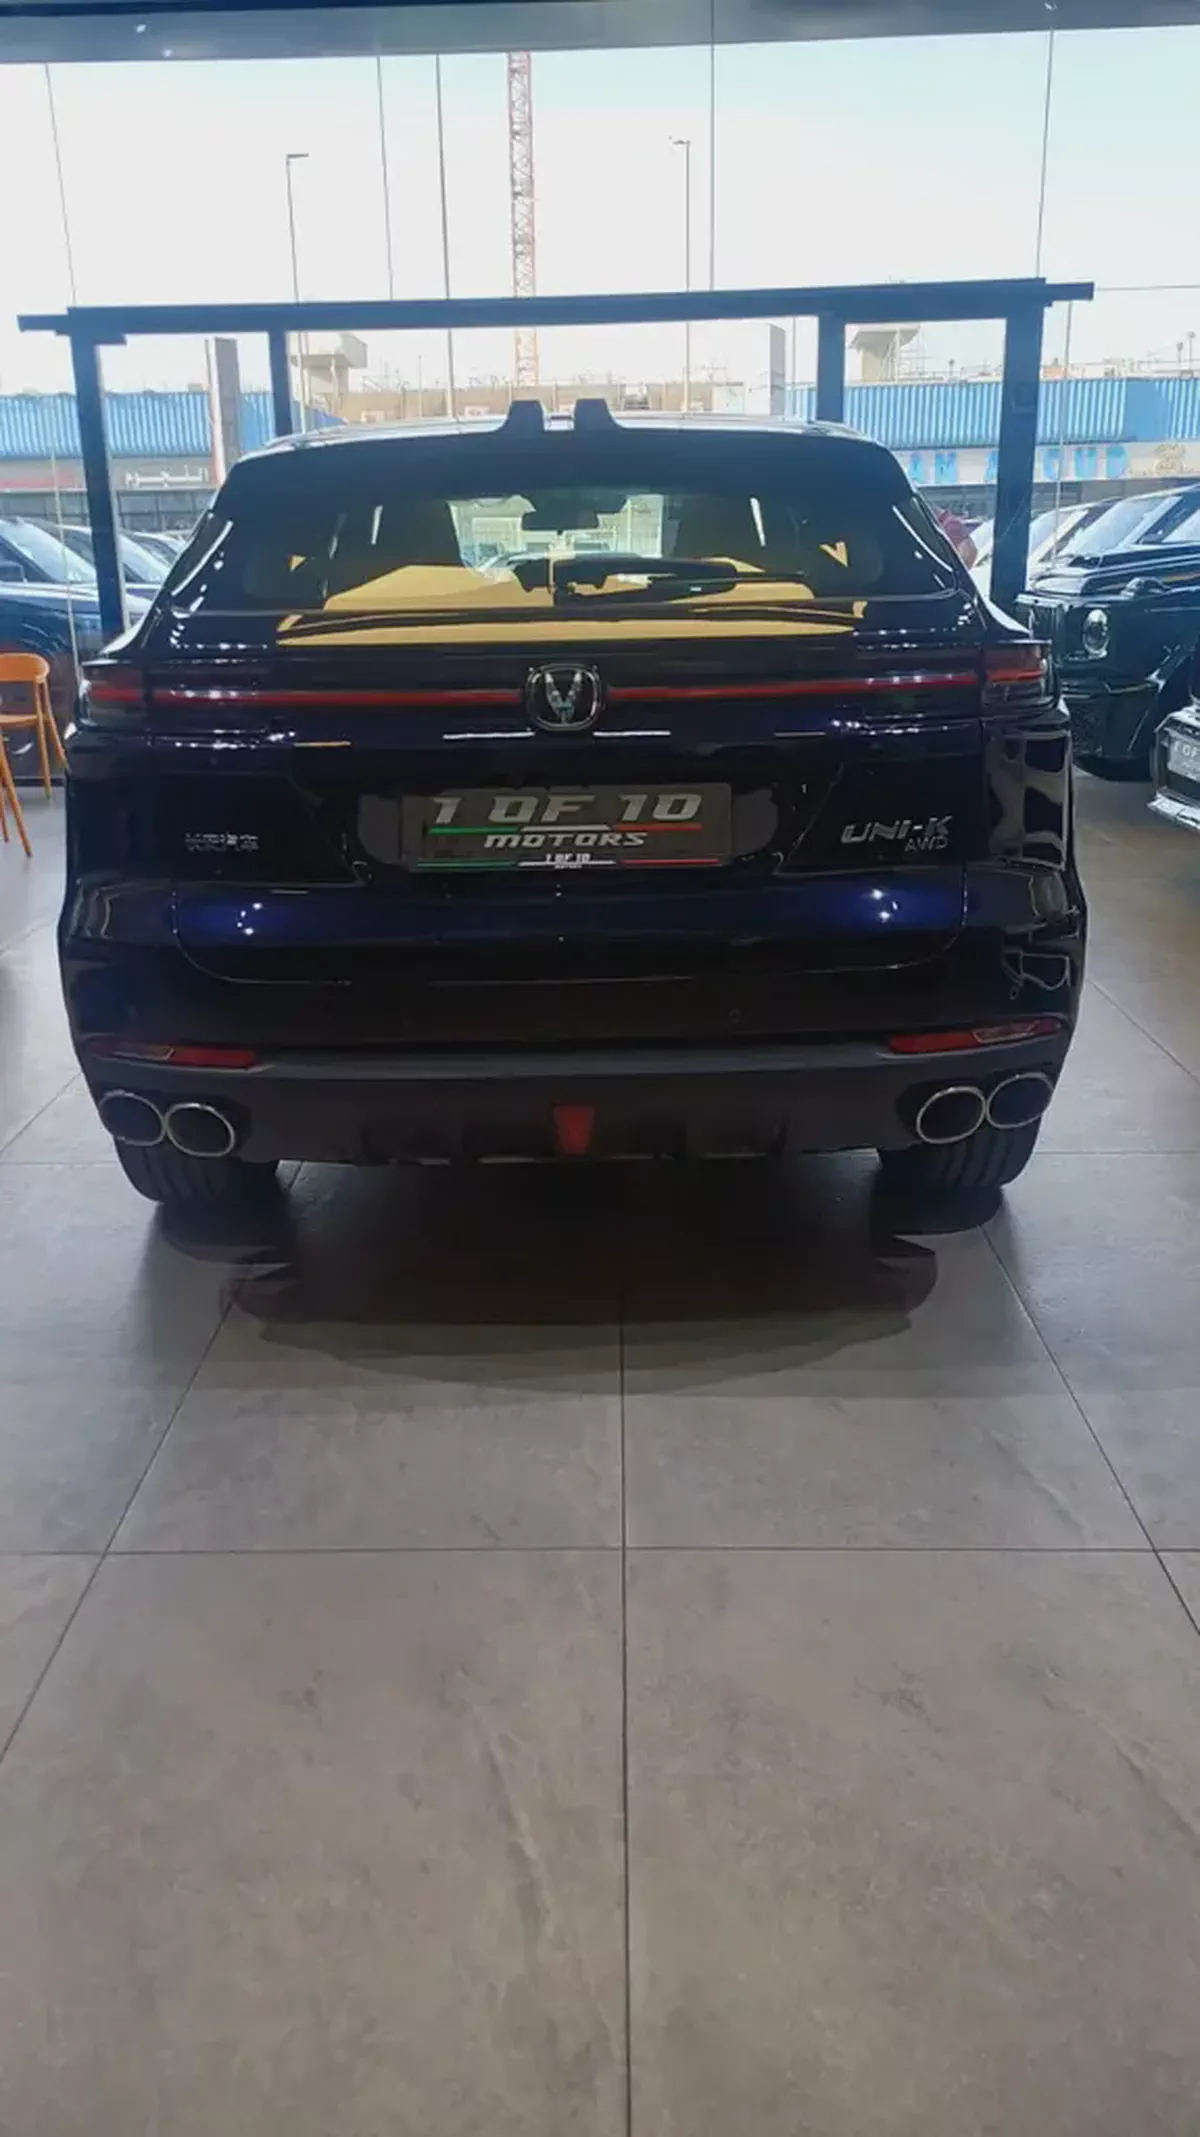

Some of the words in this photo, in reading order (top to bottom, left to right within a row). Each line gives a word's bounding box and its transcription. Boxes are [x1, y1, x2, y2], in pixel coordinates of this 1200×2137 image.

[432, 797, 462, 824] 1
[487, 795, 596, 824] OF
[619, 793, 703, 822] 10
[841, 815, 953, 843] UNI-K
[483, 832, 649, 849] MOTORS
[904, 835, 949, 852] AWD
